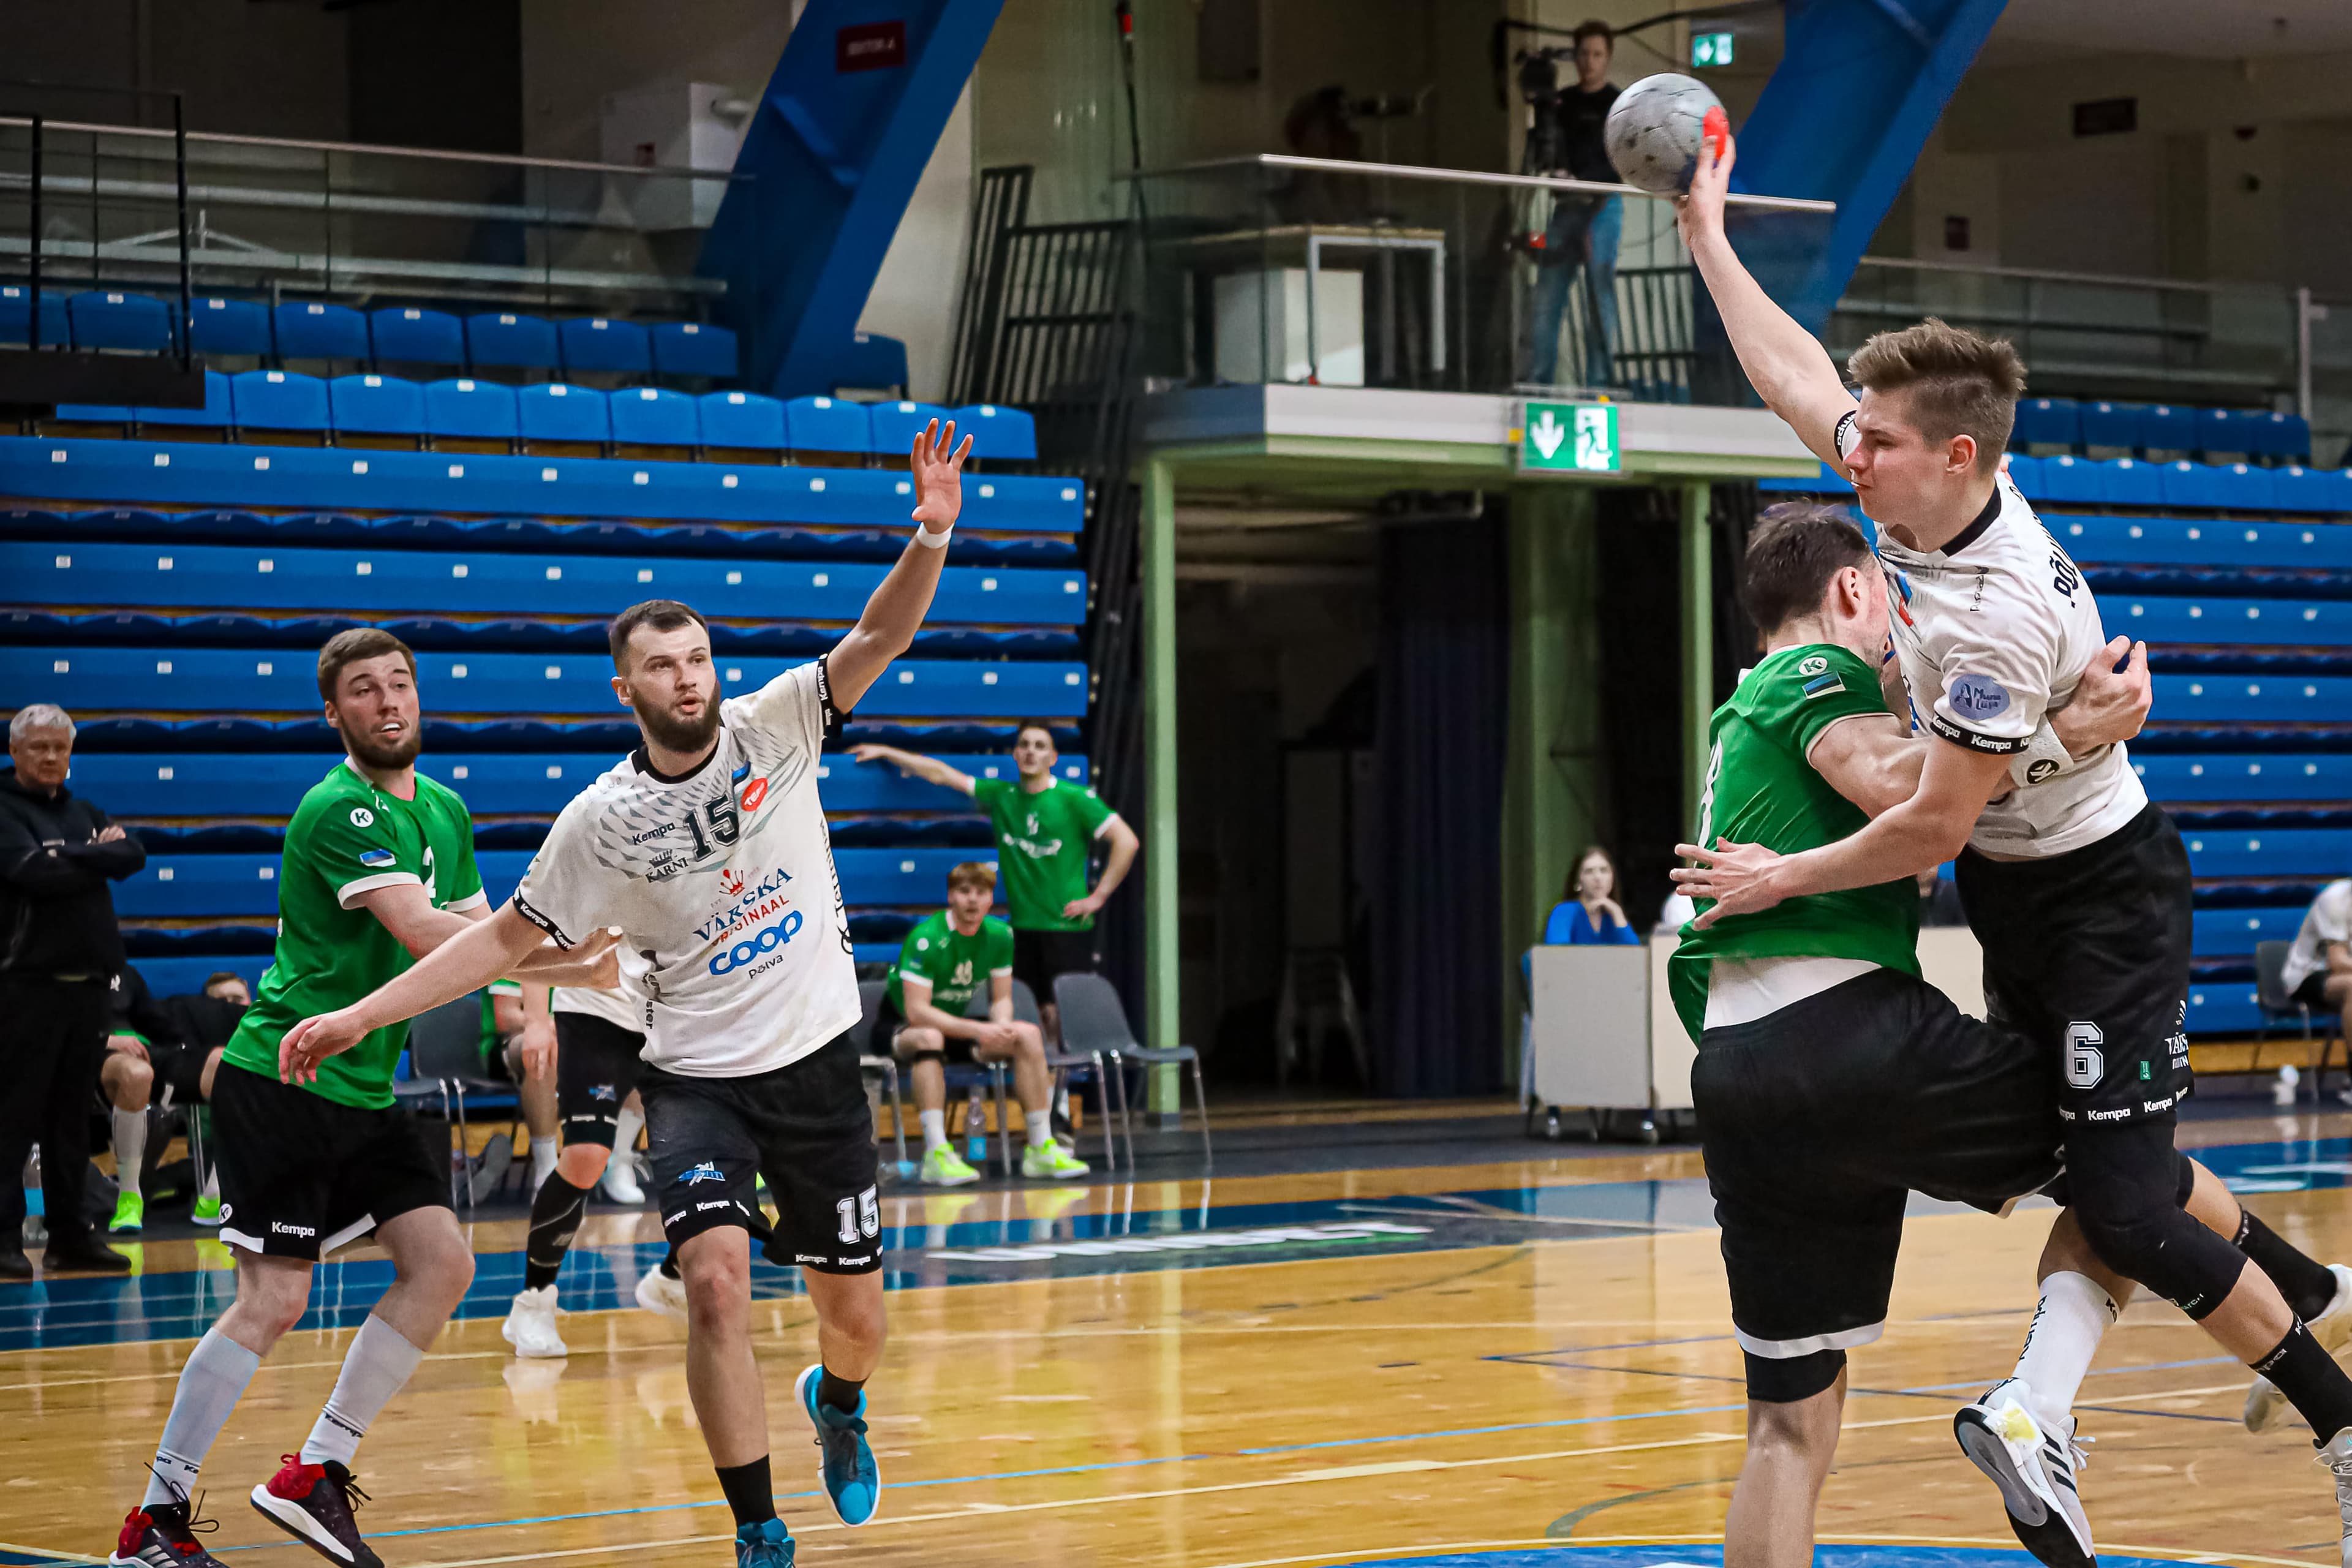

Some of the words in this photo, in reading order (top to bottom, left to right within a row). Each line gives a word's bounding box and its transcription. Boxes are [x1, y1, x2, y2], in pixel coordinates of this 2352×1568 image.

[1970, 735, 2011, 752] Kempa
[632, 822, 676, 846] Kempa
[683, 790, 740, 862] 15
[645, 857, 690, 884] KARNI
[2065, 1021, 2103, 1089] 6
[2087, 1107, 2132, 1121] Kempa
[2144, 1098, 2173, 1113] Kempa
[696, 1200, 731, 1212] Kempa
[837, 1183, 880, 1245] 15
[271, 1221, 316, 1238] Kempa
[795, 1254, 828, 1265] Kempa
[838, 1256, 872, 1267] Kempa
